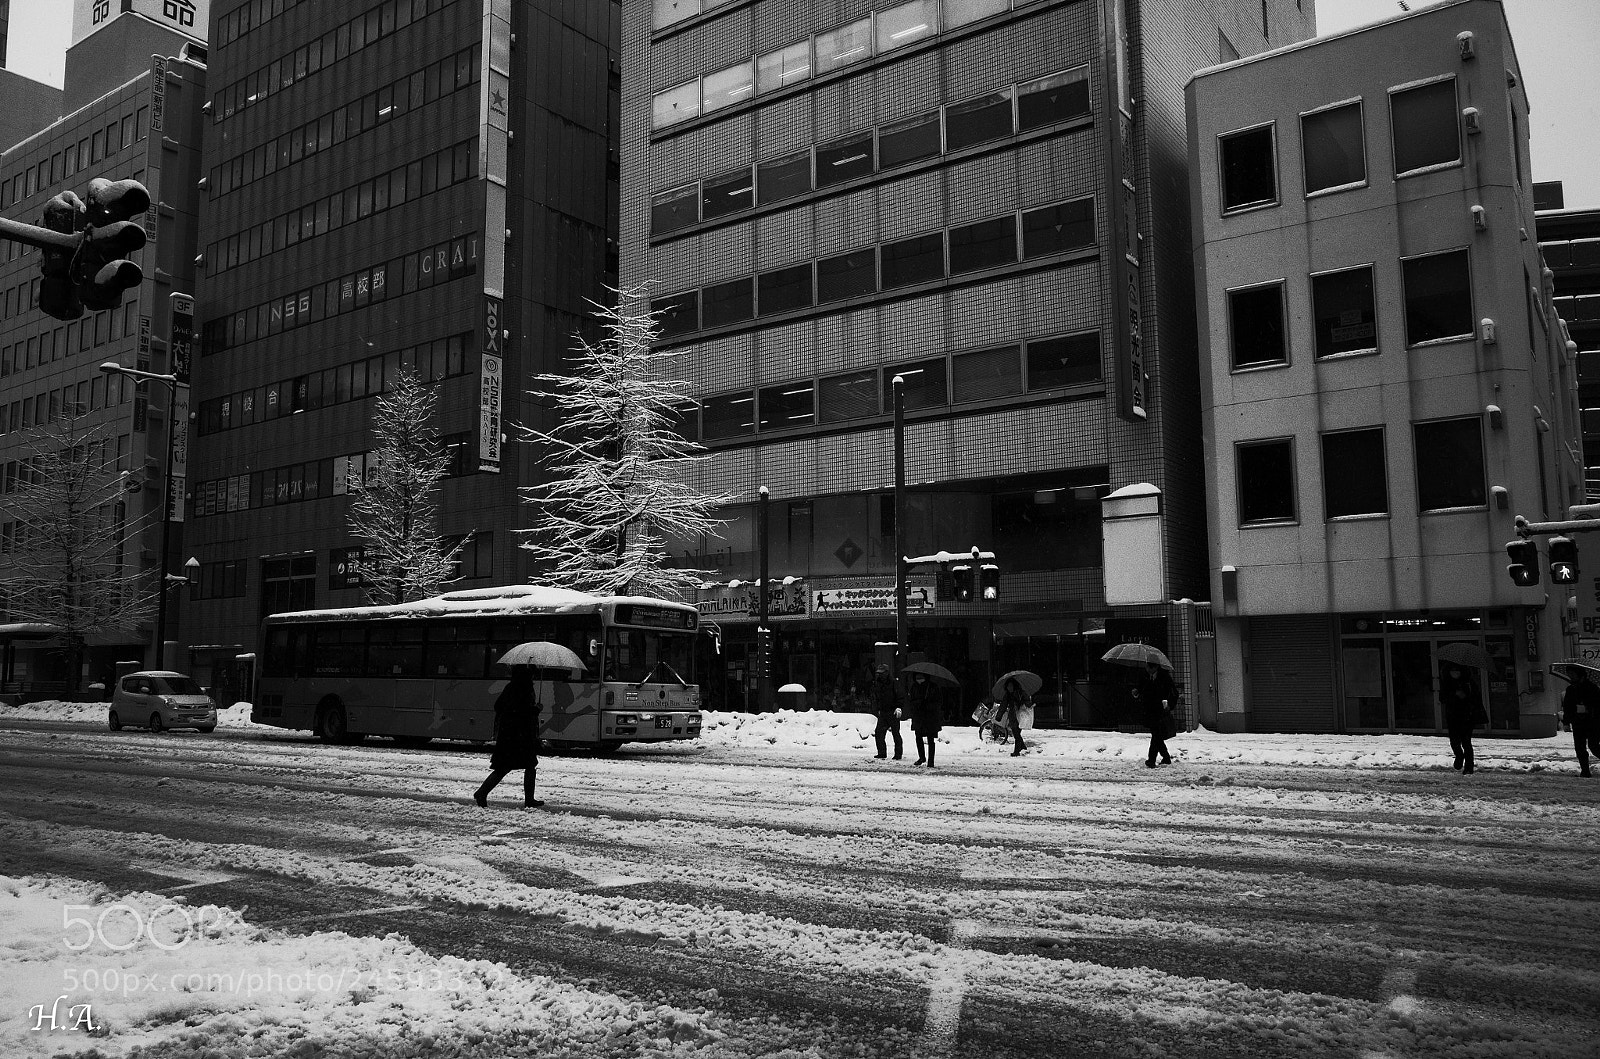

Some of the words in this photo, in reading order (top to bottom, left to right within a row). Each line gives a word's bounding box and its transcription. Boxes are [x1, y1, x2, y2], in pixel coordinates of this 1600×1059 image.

[271, 295, 310, 322] NSG
[342, 270, 385, 300] 高校部
[422, 240, 477, 274] CRAI
[177, 301, 190, 312] 3F
[487, 301, 498, 352] NOX
[684, 546, 733, 568] Noël
[699, 597, 748, 612] MALAIKA
[1526, 615, 1538, 656] KOBAN
[656, 699, 669, 707] Step
